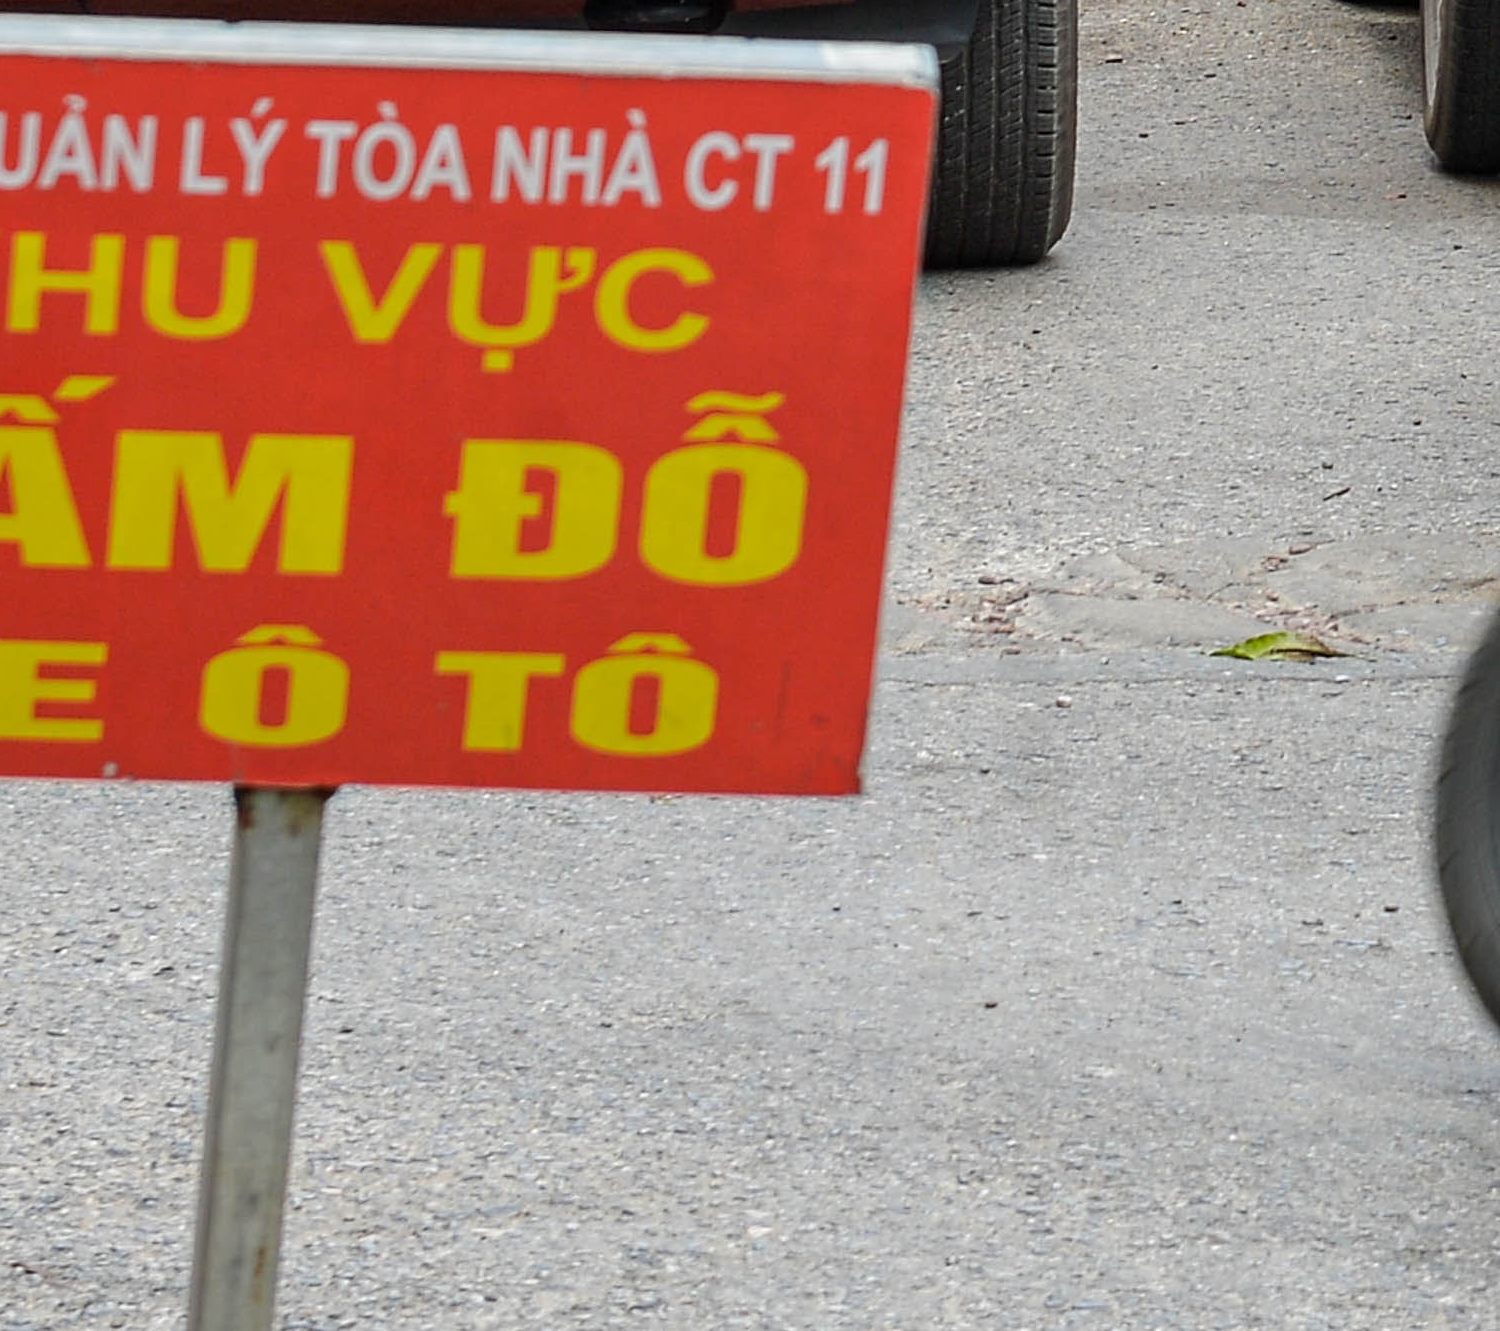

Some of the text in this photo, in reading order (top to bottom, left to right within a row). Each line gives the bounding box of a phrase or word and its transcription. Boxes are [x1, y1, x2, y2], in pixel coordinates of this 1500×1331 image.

[180, 97, 288, 197] LÝ
[304, 101, 471, 201] TÒA
[491, 108, 661, 208] NHÀ
[683, 131, 794, 213] CT
[814, 135, 889, 215] 11
[318, 239, 716, 372] VỰC
[443, 391, 809, 587] ĐỖ
[199, 623, 350, 748] Ô
[434, 632, 720, 757] TÔ
